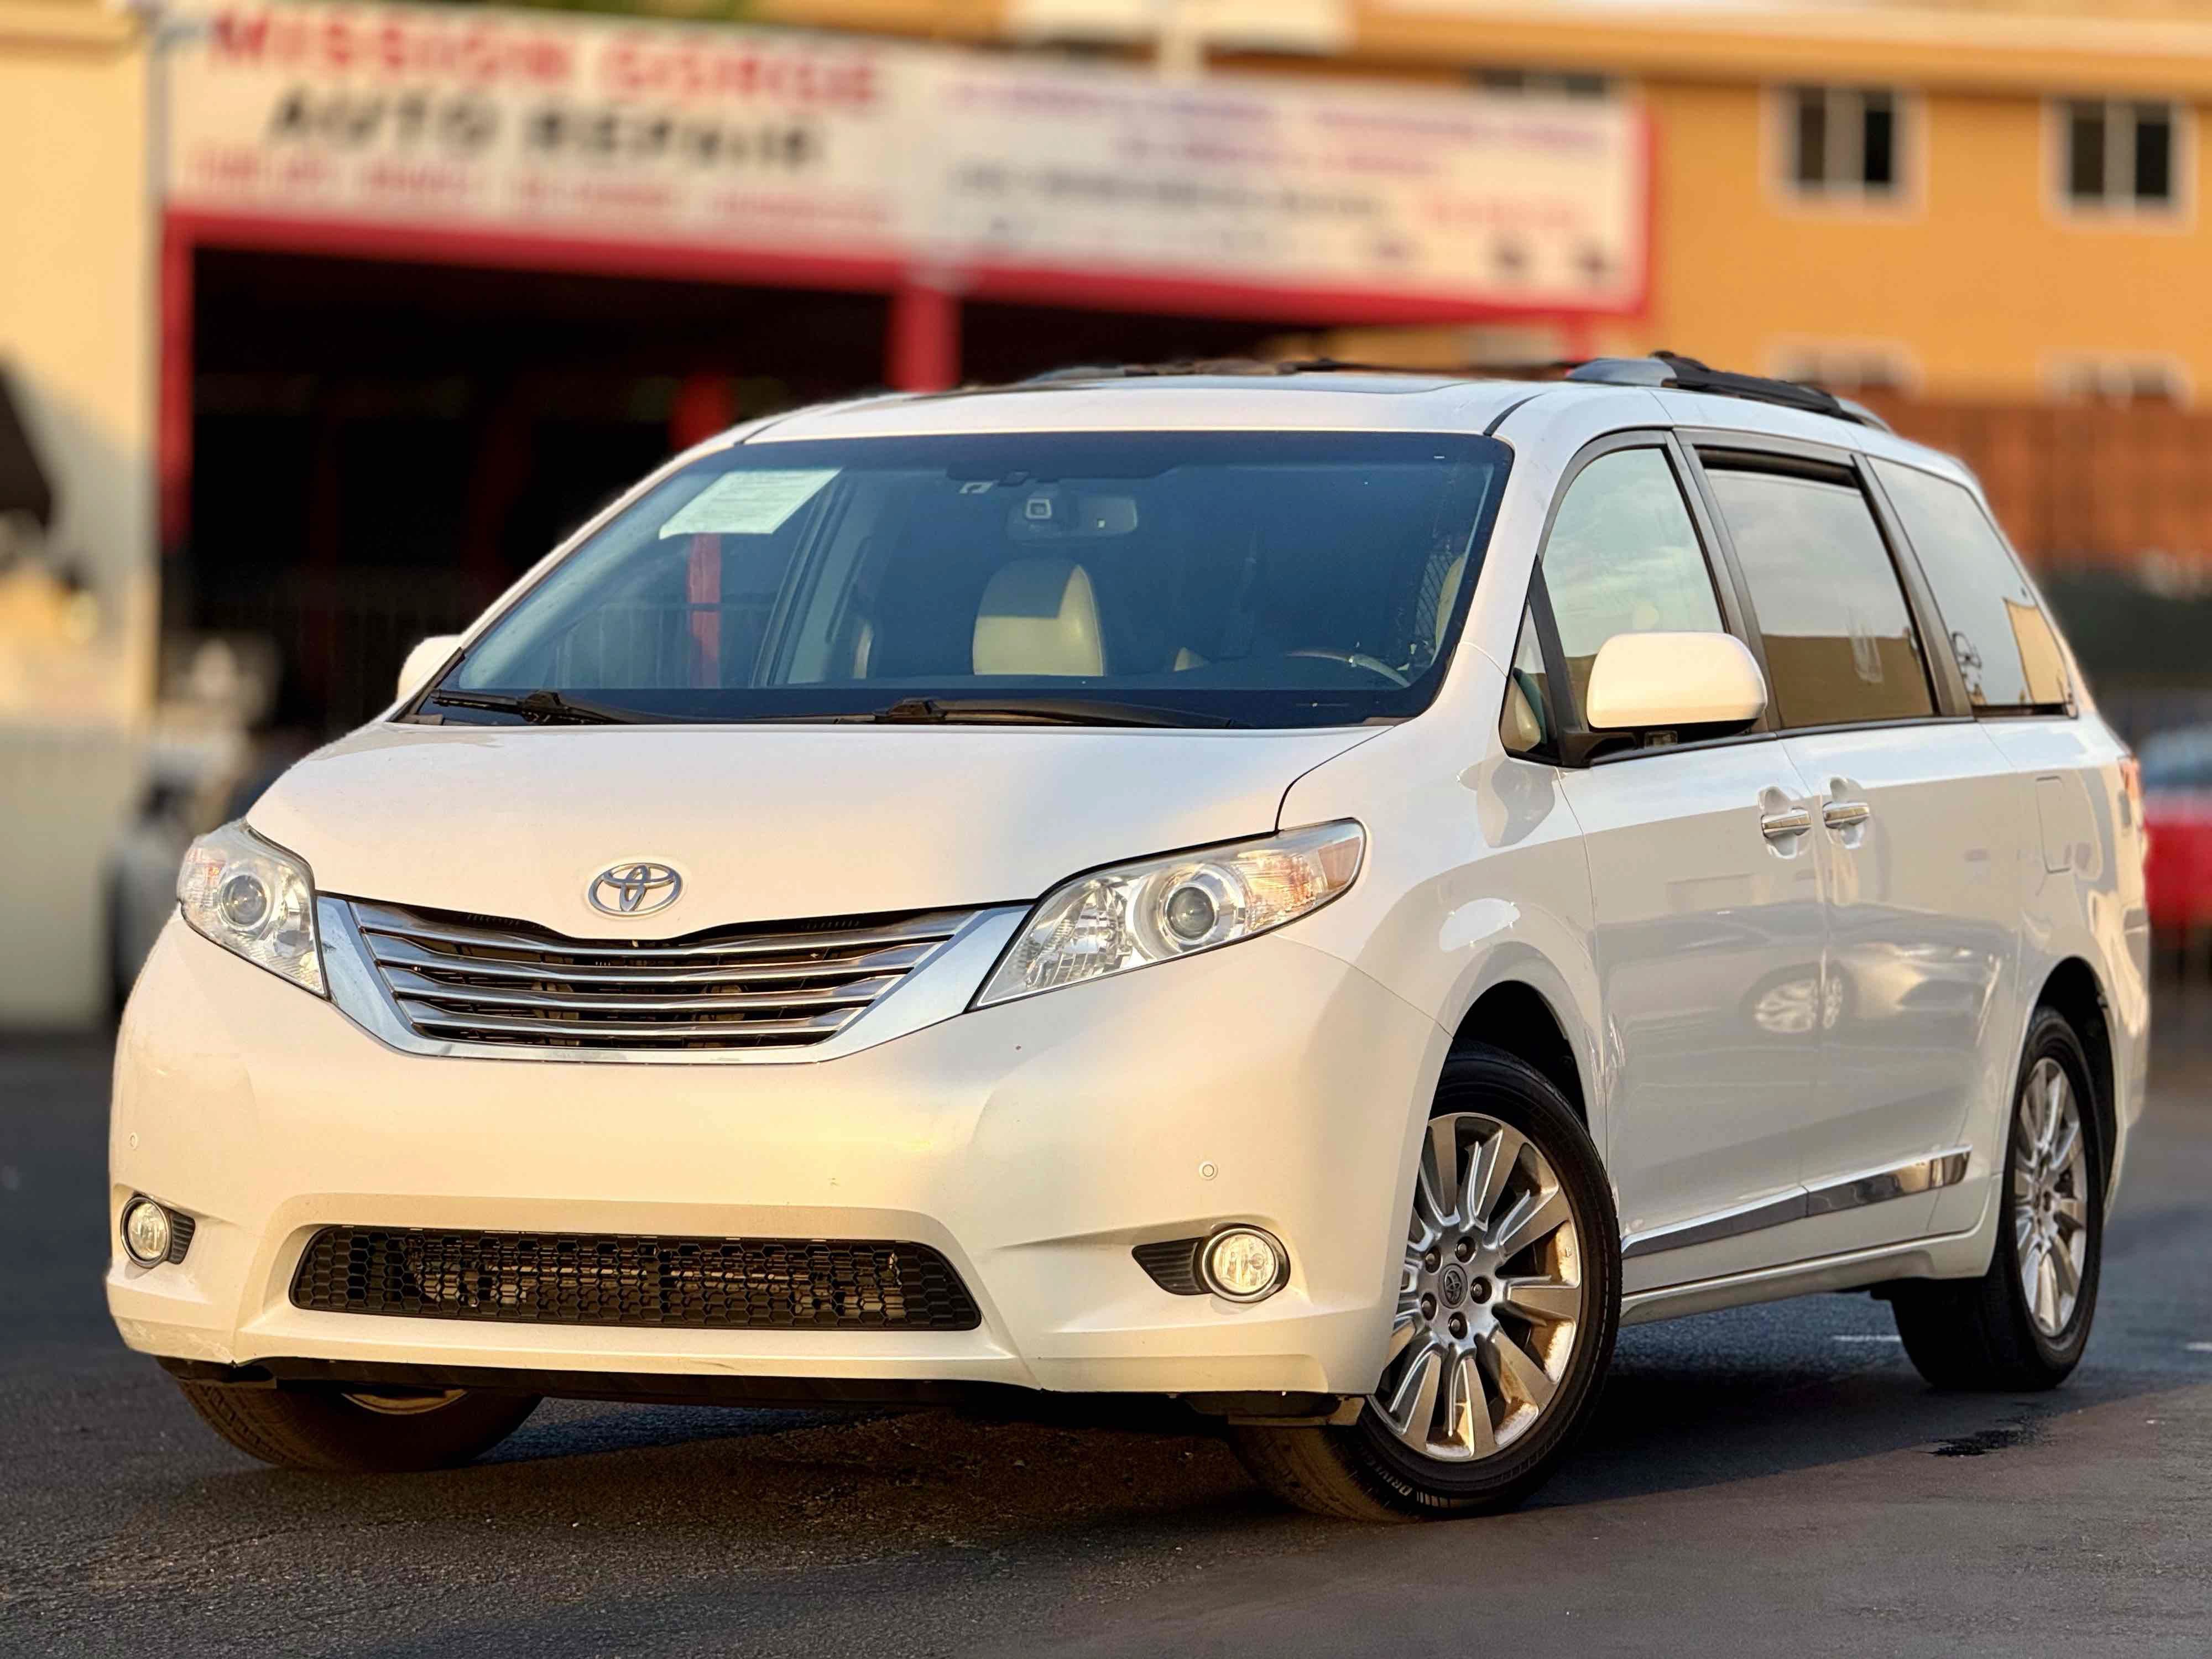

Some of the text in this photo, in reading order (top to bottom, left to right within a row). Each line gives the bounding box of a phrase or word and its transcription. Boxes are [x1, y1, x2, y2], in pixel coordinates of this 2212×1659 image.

[210, 12, 571, 82] MISSION
[269, 86, 826, 168] AUTO REPAIR
